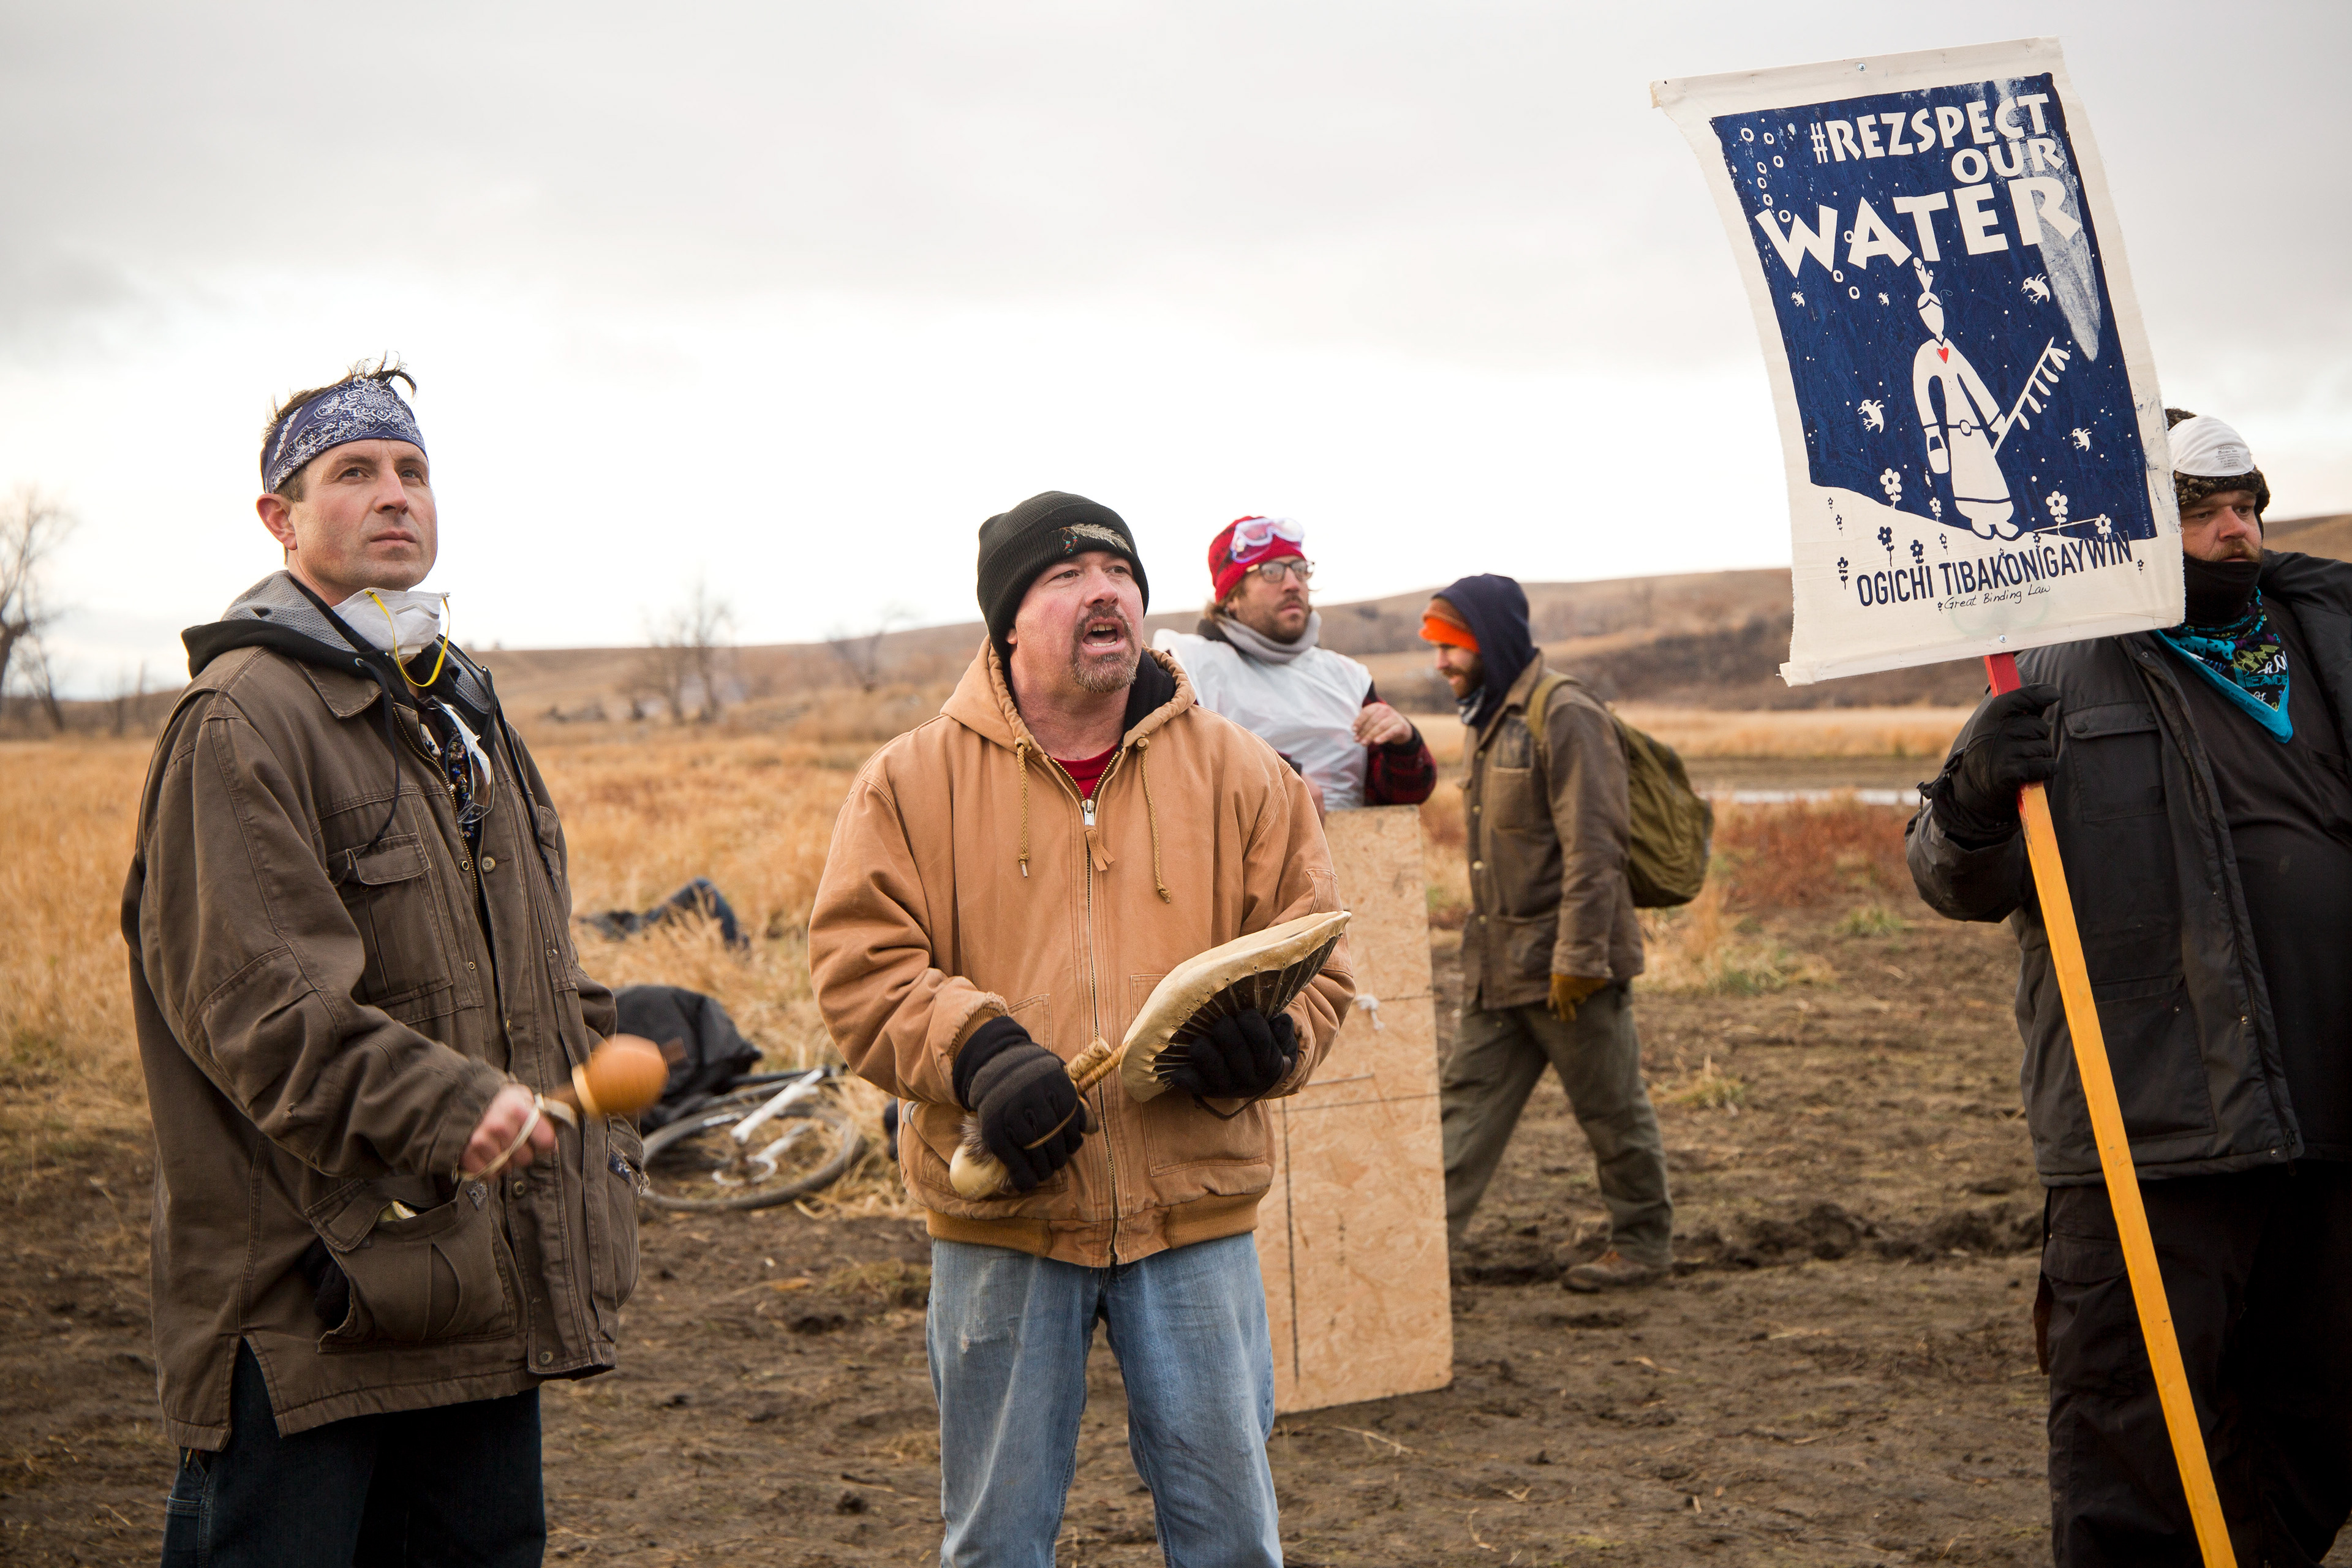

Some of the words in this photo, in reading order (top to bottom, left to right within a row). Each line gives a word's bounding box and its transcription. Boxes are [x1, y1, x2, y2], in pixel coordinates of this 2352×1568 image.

[1810, 92, 2049, 164] #REZSPECT
[1951, 137, 2065, 184] OUR
[1754, 176, 2082, 278] WATER
[1856, 564, 1935, 607] OGICHI
[1944, 594, 1977, 609] Great
[1983, 589, 2022, 604] Binding
[2027, 584, 2051, 595] Law
